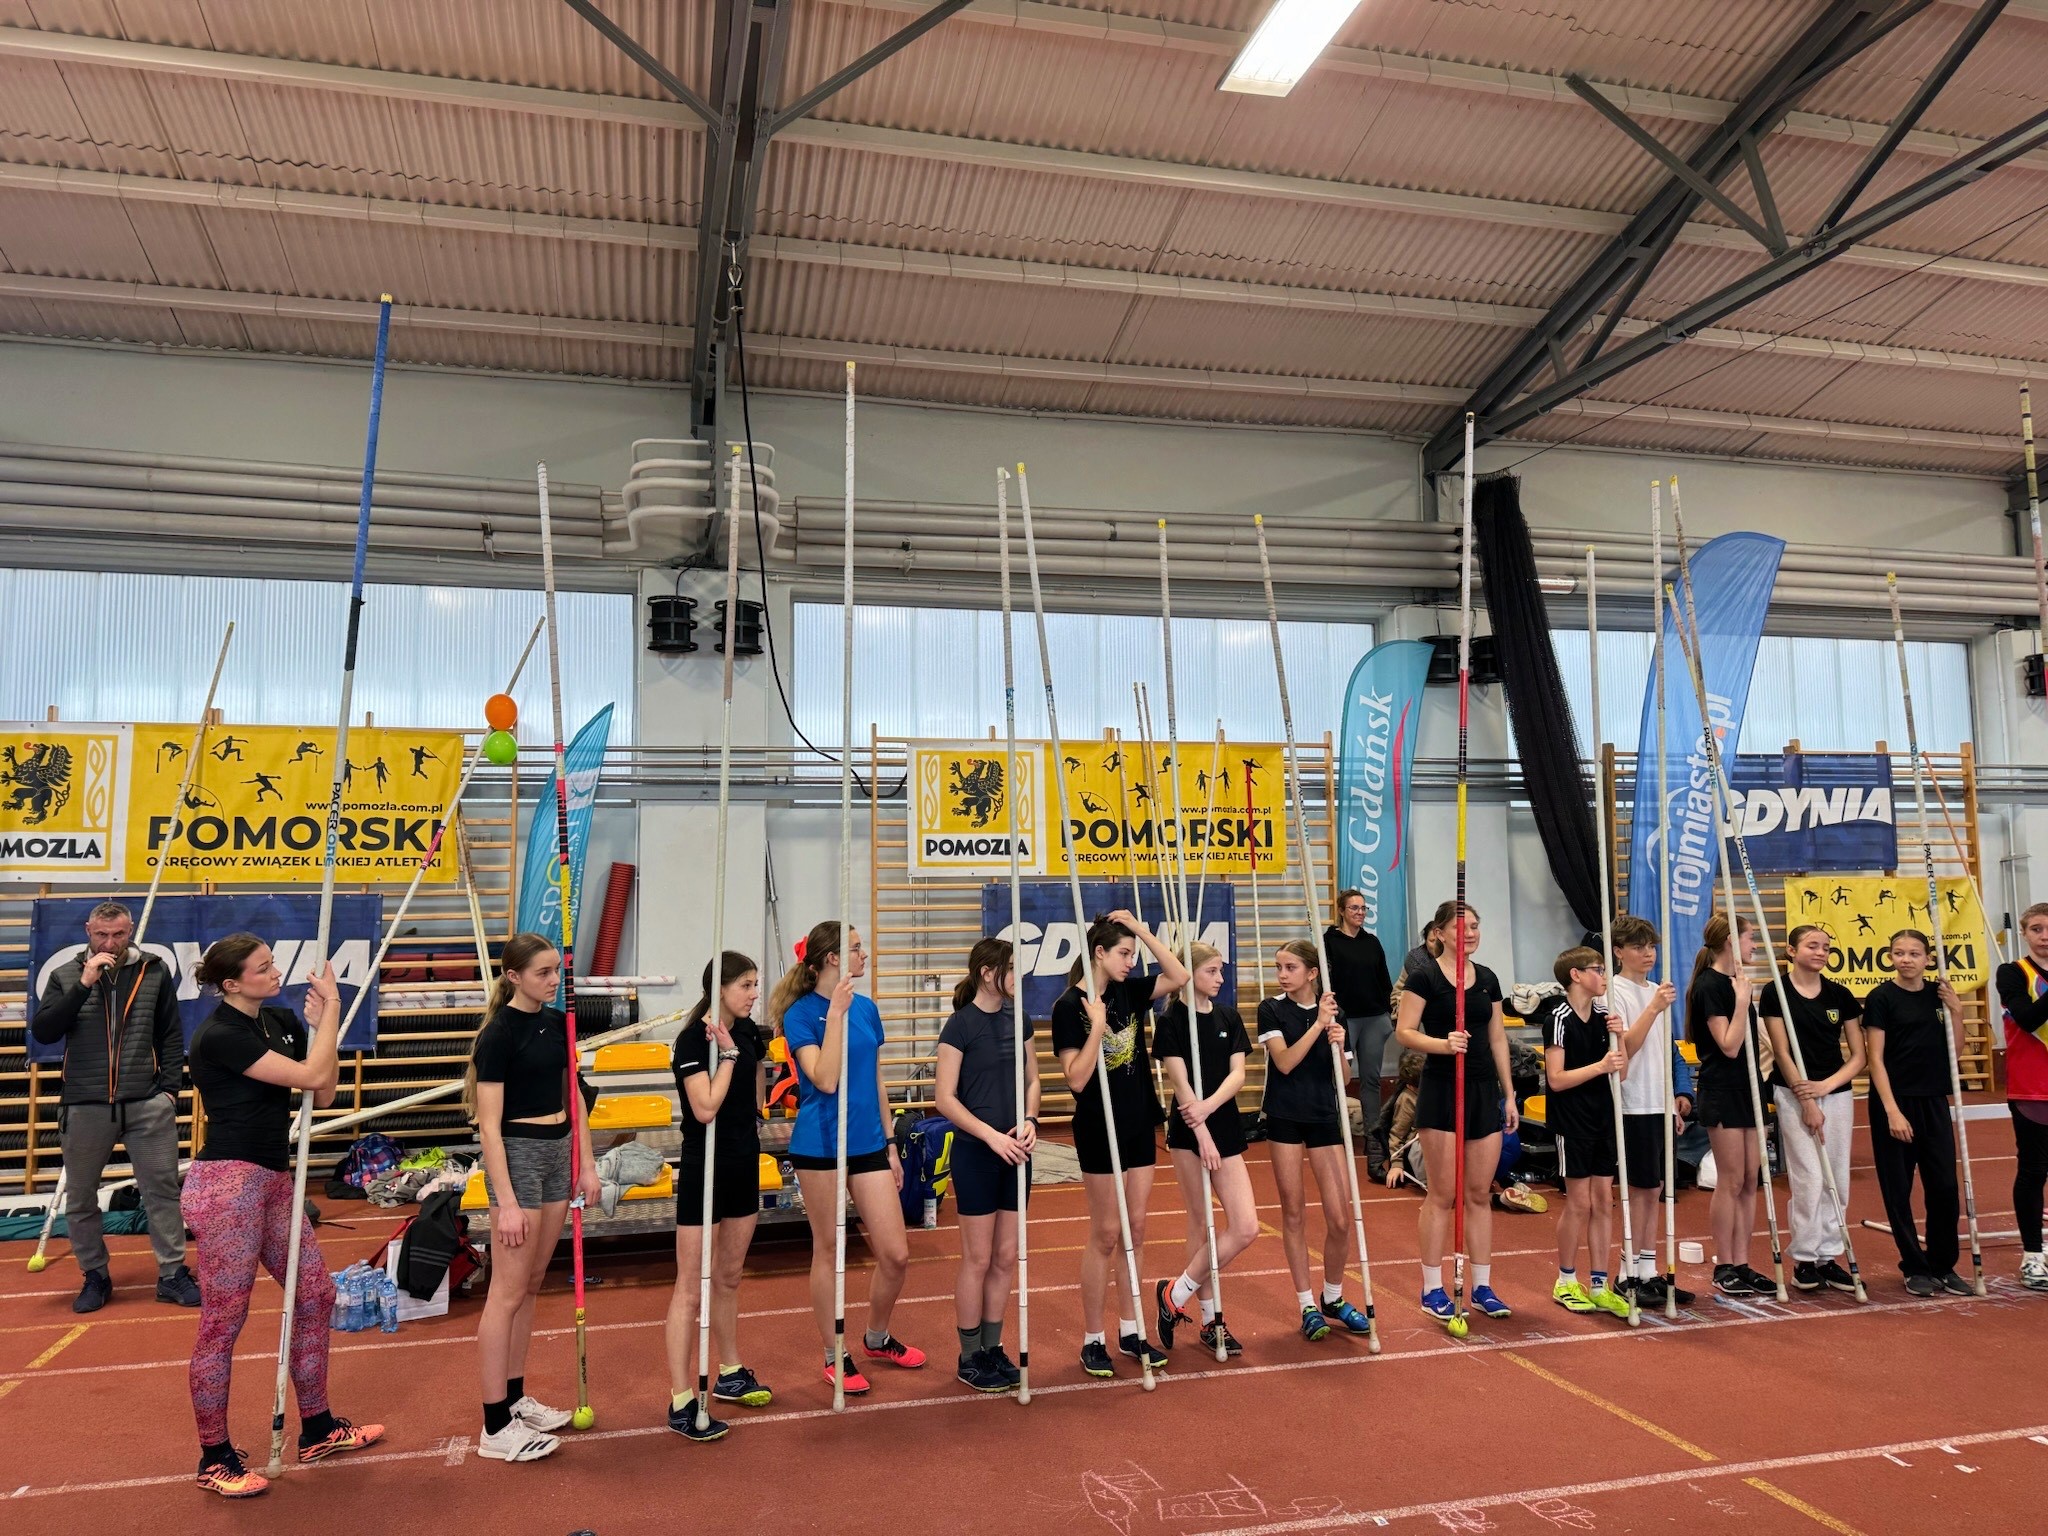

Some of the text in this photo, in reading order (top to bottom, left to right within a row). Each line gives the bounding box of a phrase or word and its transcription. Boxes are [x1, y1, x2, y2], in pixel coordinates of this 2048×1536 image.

[1704, 727, 1714, 762] PACER
[1348, 686, 1394, 854] Gdańsk
[305, 801, 443, 813] ww.pomozla.com.pl
[331, 782, 342, 831] PACER
[0, 838, 102, 859] MOZLA
[148, 816, 442, 851] POMORSKI
[1061, 818, 1273, 849] POMORSKI
[242, 857, 311, 869] ZWIĄZEK
[315, 857, 371, 867] LKKIEJ
[1061, 852, 1126, 864] ORĘGOWY
[1227, 853, 1273, 862] ATLEYKI
[1737, 837, 1751, 870] PACER
[1924, 842, 1935, 878] PACER
[1351, 864, 1379, 937] dio
[1825, 944, 1976, 974] OMOSKI
